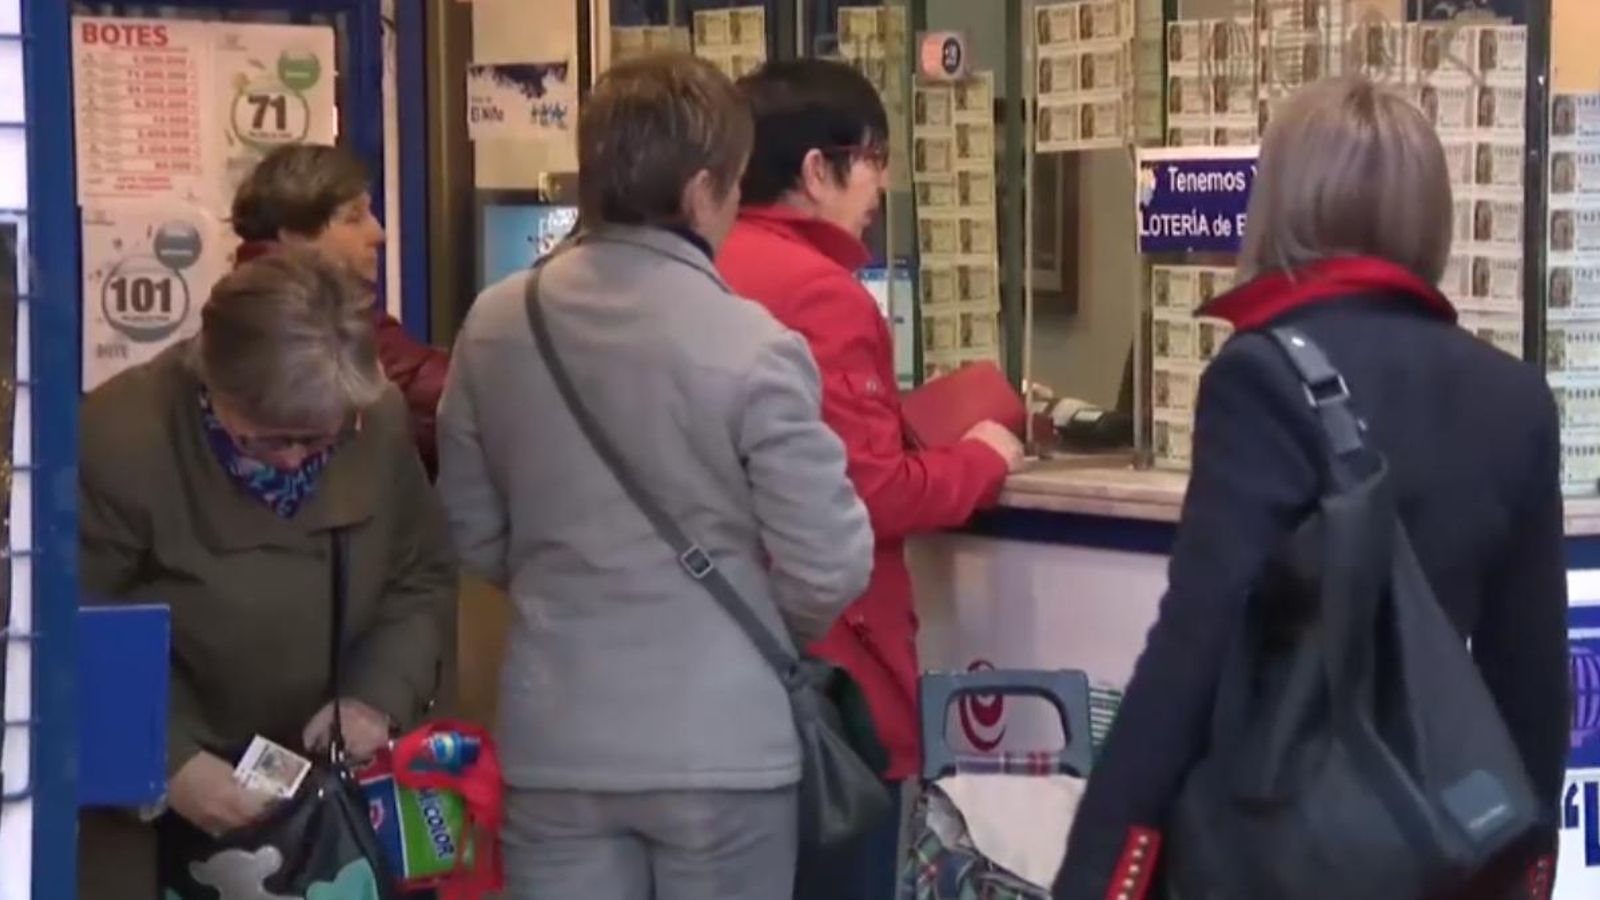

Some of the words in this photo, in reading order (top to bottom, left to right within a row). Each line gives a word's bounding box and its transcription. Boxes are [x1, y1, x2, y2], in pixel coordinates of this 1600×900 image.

[81, 23, 168, 46] BOTES
[247, 94, 287, 131] 71
[1168, 165, 1246, 192] Tenemos
[1140, 208, 1210, 237] LOTERÍA
[1213, 213, 1232, 237] de
[110, 276, 172, 313] 101
